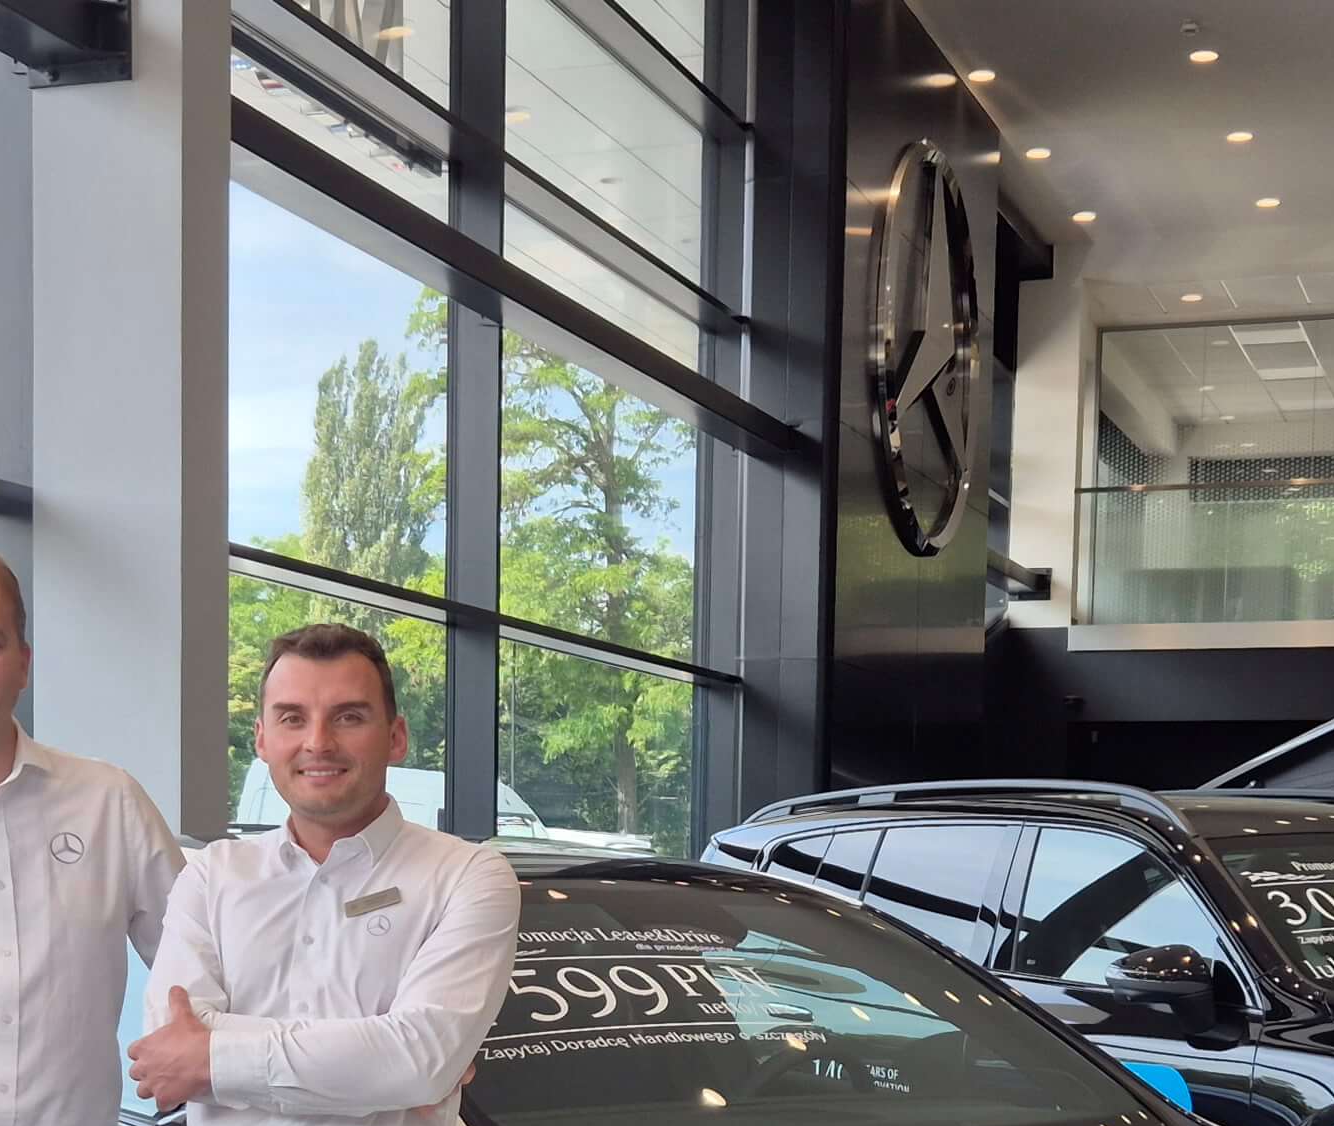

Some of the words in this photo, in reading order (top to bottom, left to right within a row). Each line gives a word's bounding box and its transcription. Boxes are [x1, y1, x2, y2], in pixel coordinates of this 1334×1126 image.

[516, 927, 597, 945] omocja
[593, 927, 725, 945] Lease&Drive
[657, 963, 781, 998] PLN
[483, 1041, 552, 1061] Zapytaj
[553, 1035, 627, 1054] Doradcę
[630, 1029, 735, 1046] Handlowego
